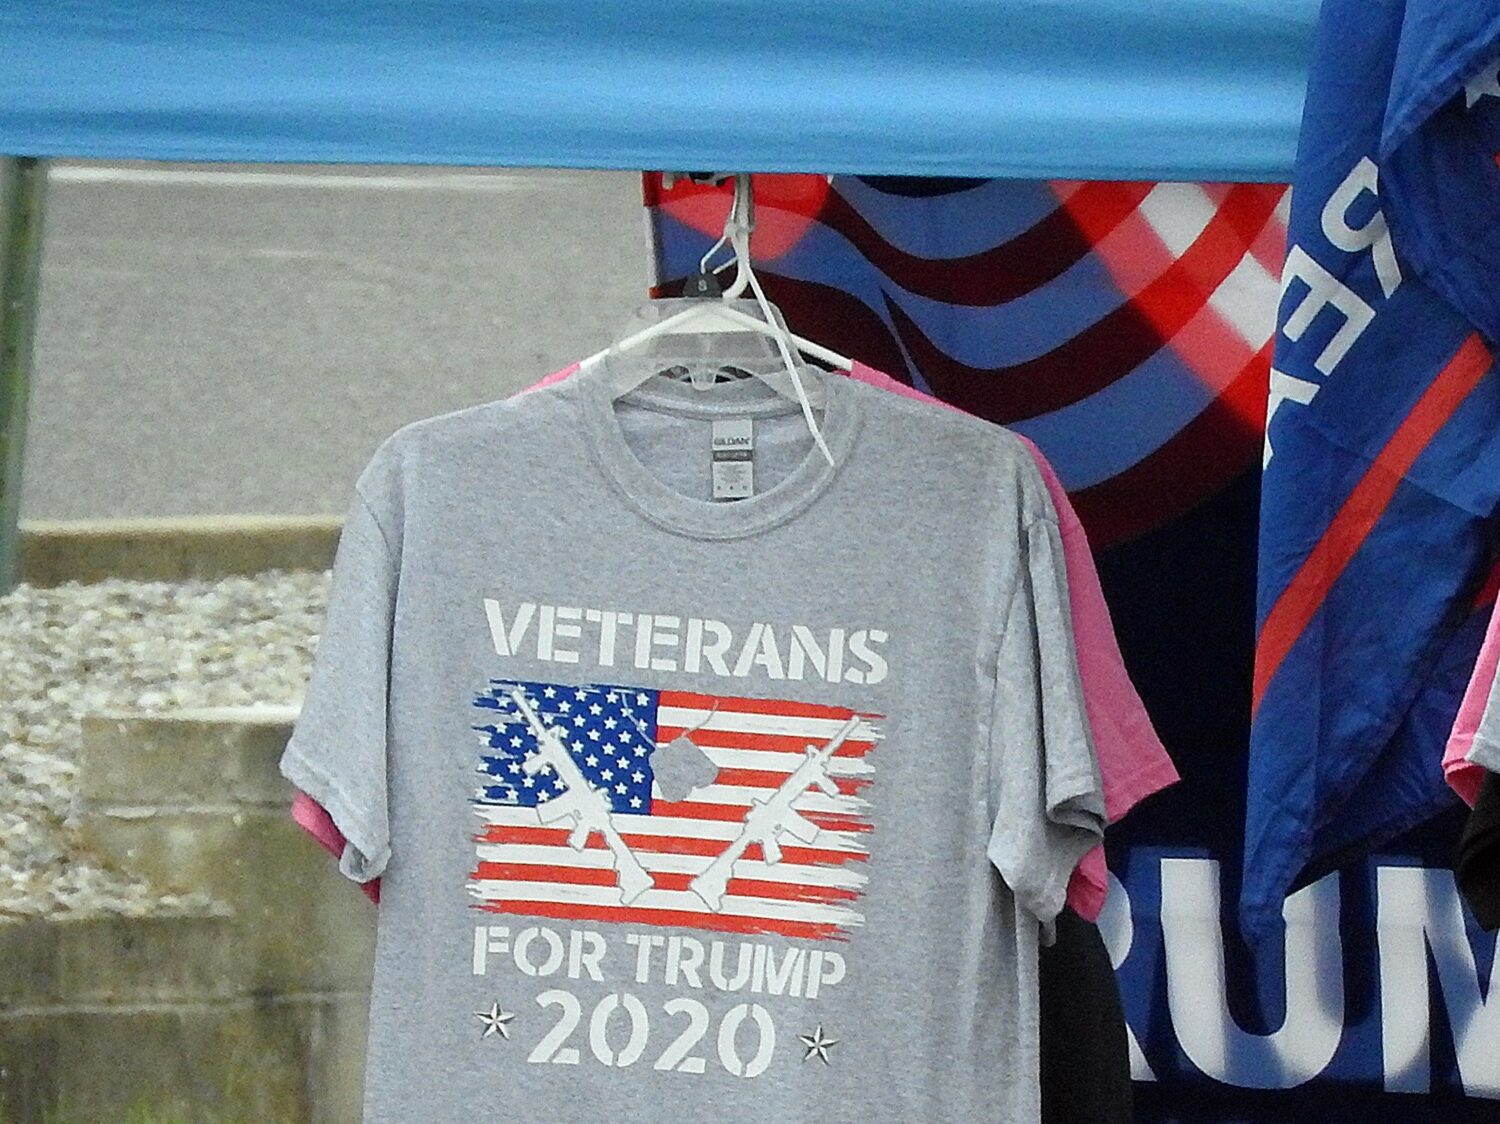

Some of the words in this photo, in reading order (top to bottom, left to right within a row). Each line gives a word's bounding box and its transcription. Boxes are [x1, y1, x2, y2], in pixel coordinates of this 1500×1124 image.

[484, 598, 889, 685] VETERANS
[472, 927, 605, 984] FOR
[625, 933, 847, 1000] TRUMP
[526, 990, 776, 1078] 2020
